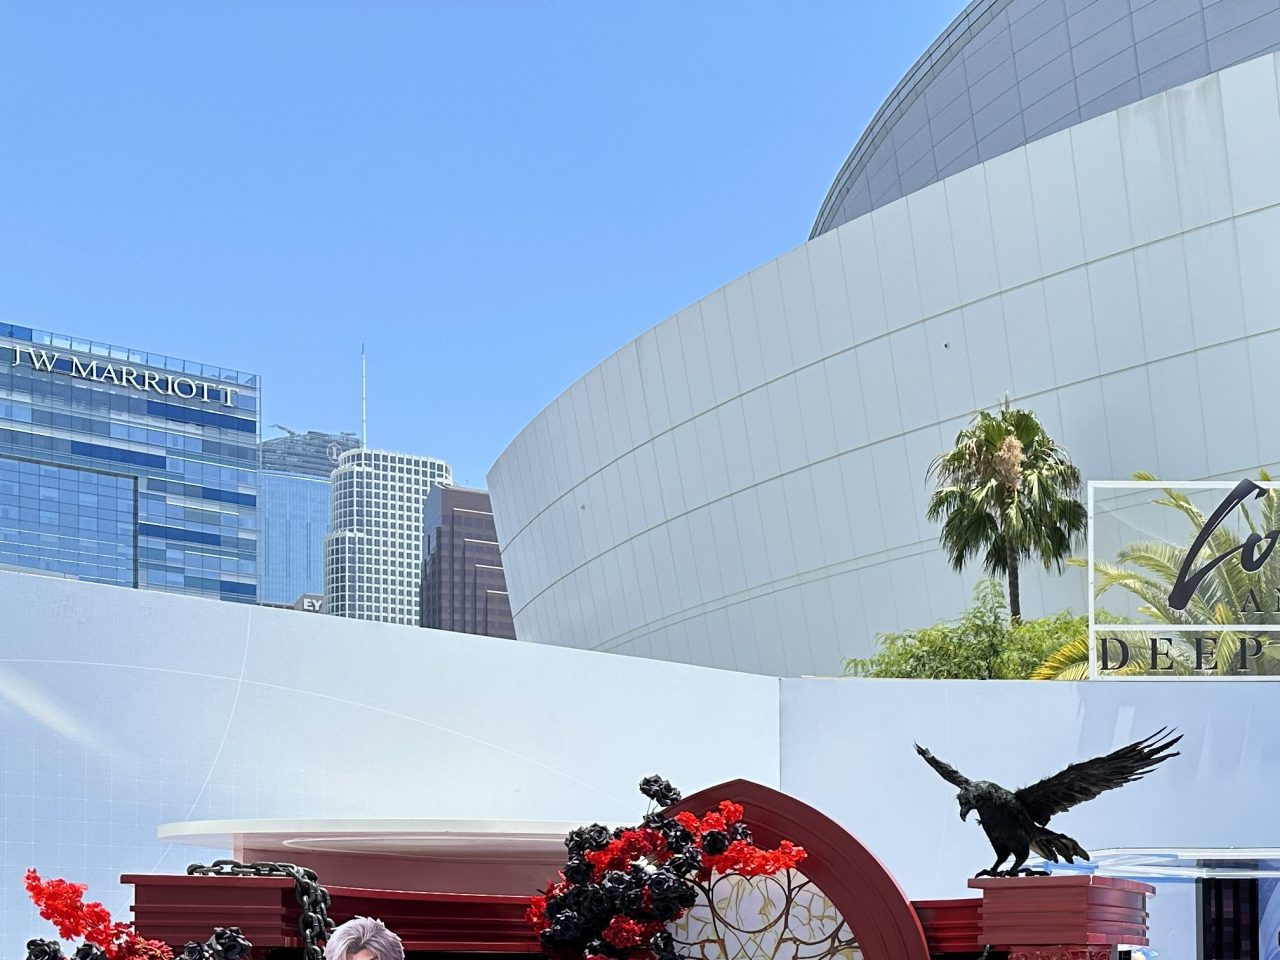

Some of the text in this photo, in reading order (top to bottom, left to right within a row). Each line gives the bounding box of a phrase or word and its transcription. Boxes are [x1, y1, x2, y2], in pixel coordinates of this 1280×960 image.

[12, 345, 239, 407] JW MARRIOTT
[303, 599, 322, 611] EY
